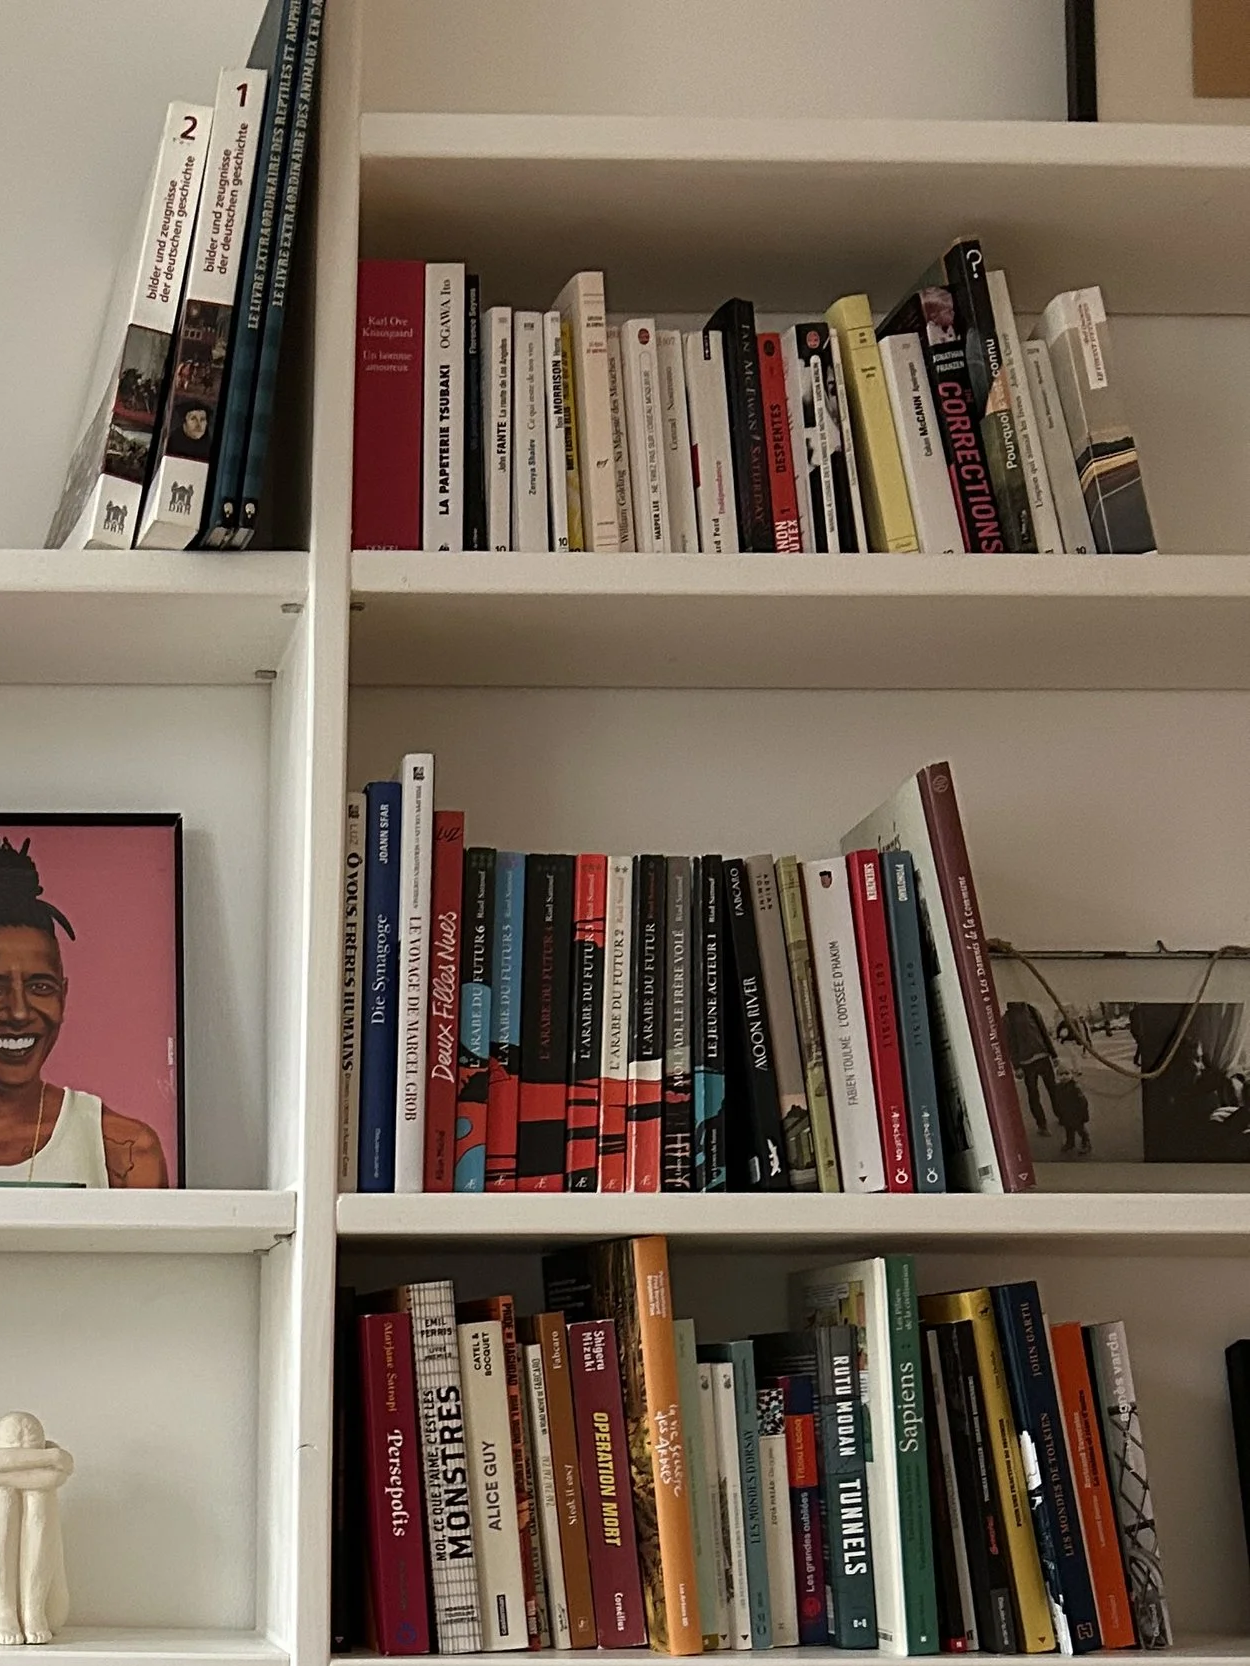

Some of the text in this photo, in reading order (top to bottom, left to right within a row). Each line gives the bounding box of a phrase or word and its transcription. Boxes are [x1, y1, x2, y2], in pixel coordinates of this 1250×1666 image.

[282, 43, 295, 61] ET
[180, 115, 198, 141] 2
[236, 82, 248, 107] 1
[274, 62, 293, 125] REPTILES
[270, 127, 284, 150] DES
[159, 154, 199, 303] der deutschen geschichte
[202, 148, 235, 272] bilder und zeugnisse
[216, 122, 251, 274] der deutschen geschichte
[254, 151, 281, 270] EXTRAORDINAIRE
[145, 179, 180, 299] bilder und zeugnisse
[247, 312, 260, 329] LE
[249, 272, 265, 311] LIVRE
[438, 279, 451, 515] LA PAPETERIE TSUBAKI OGAWA Ito
[552, 360, 562, 414] MORRISON
[554, 416, 562, 428] Toni
[770, 402, 786, 473] DESPENTES
[935, 378, 1005, 553] CORRECTIONS
[997, 410, 1019, 469] Pourquoi
[379, 804, 389, 863] JOANN SFAR
[340, 852, 364, 1070] Ô VOUS FRÈRES HUMAINS
[371, 913, 391, 1023] Die Synagoge
[431, 910, 457, 1082] Deux Filles Nues
[469, 925, 485, 1067] L'ARABE DU FUTUR 6
[706, 942, 717, 995] ACTEUR
[403, 915, 423, 1121] LE VOYAGE DE MARCEL GROB
[707, 997, 717, 1040] JEUNE
[707, 1042, 717, 1057] LE
[742, 976, 769, 1071] MOON RIVER
[828, 940, 858, 1105] FABIEN TOULMÉ L'ODYSSÉE D'HAKIM
[420, 1328, 452, 1338] FERRIS
[425, 1318, 446, 1327] EMIL
[472, 1342, 482, 1370] CATEL
[480, 1332, 492, 1376] BOCQUET
[581, 1332, 594, 1372] Mizuki
[592, 1330, 606, 1370] Shigeru
[831, 1354, 857, 1457] RUTU MODAN
[898, 1361, 923, 1452] Sapiens
[382, 1429, 408, 1537] Persepolis
[436, 1384, 473, 1560] MONSTRES
[481, 1439, 502, 1531] ALICE GUY
[592, 1410, 621, 1547] OPERATION MORT
[838, 1478, 867, 1575] TUNNELS
[613, 1592, 626, 1631] Cornélius
